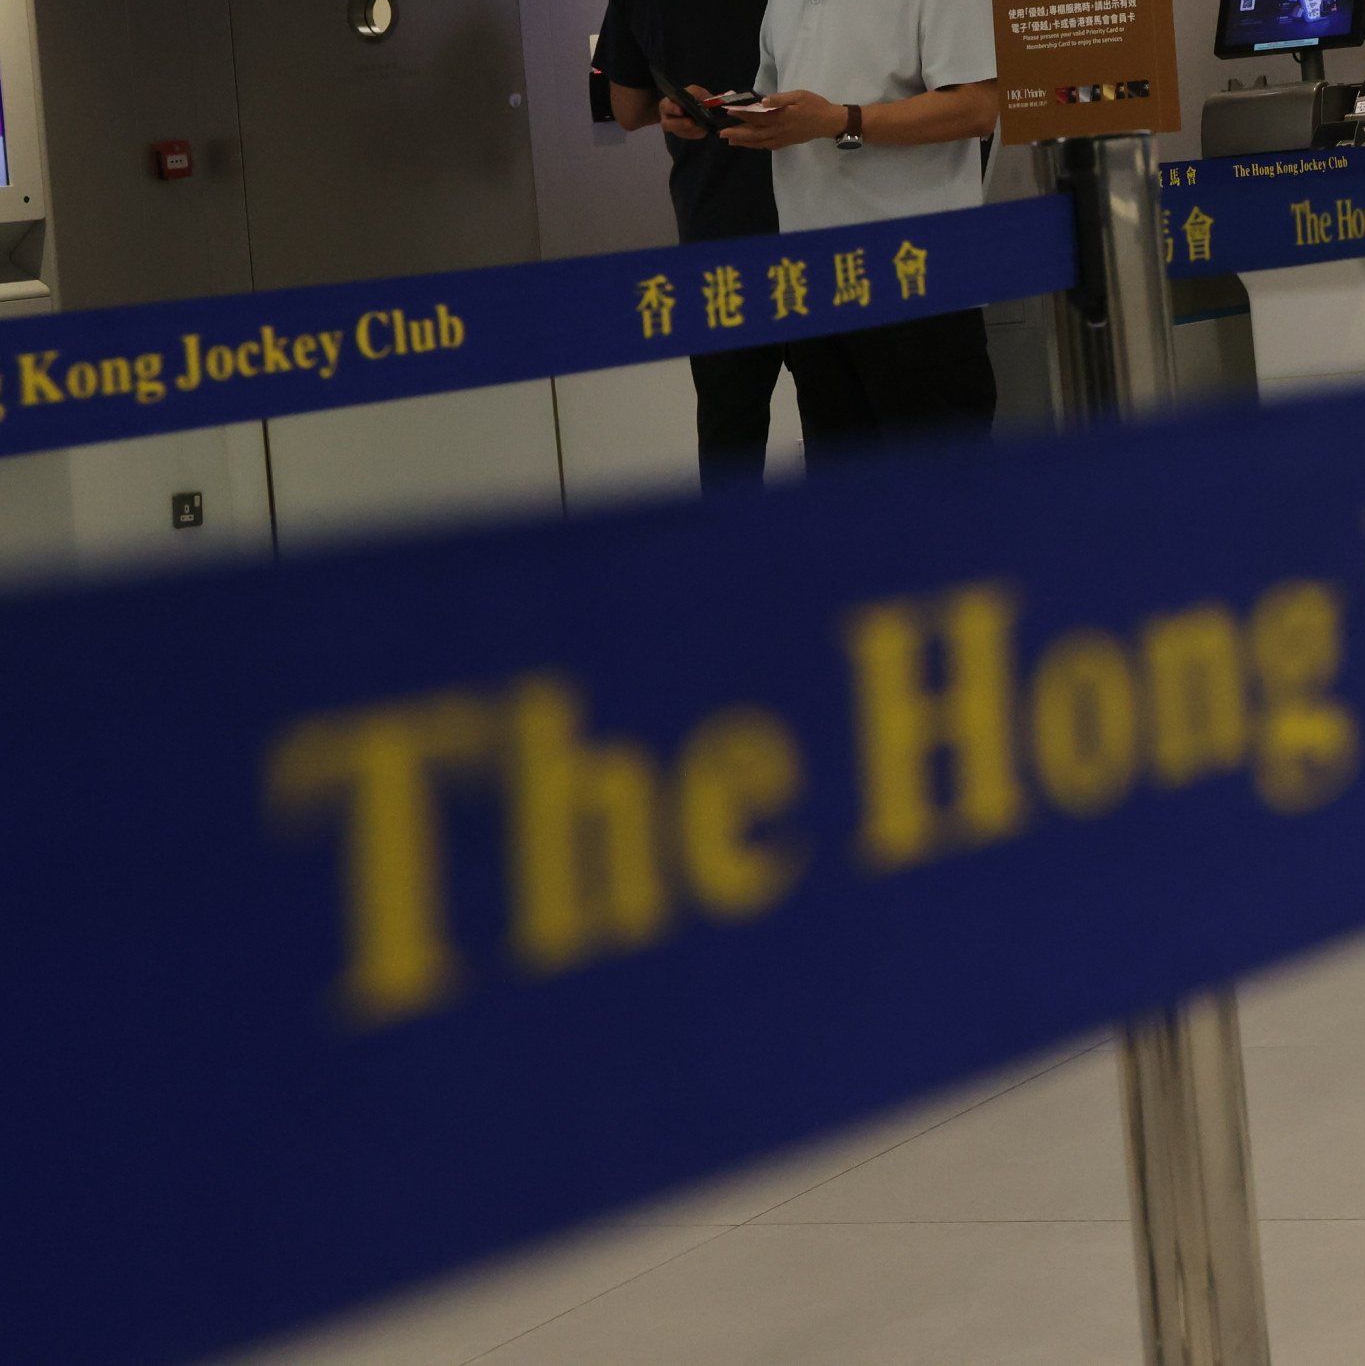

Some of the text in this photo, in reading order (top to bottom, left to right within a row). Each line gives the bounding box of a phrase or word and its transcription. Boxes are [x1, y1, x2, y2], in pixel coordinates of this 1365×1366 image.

[1026, 41, 1058, 50] Membership
[1077, 39, 1092, 47] enjoy
[1040, 33, 1060, 42] present
[1060, 31, 1072, 39] your
[1073, 29, 1086, 37] valid
[1086, 27, 1106, 36] Priority
[1233, 154, 1349, 178] The Hong Kong Jockey Club
[1291, 200, 1333, 246] The
[635, 239, 928, 339] 香港賽馬會
[16, 349, 167, 407] Kong
[174, 325, 344, 392] Jockey
[355, 303, 466, 360] Club
[262, 666, 803, 1029] The
[842, 577, 1362, 876] Hong
